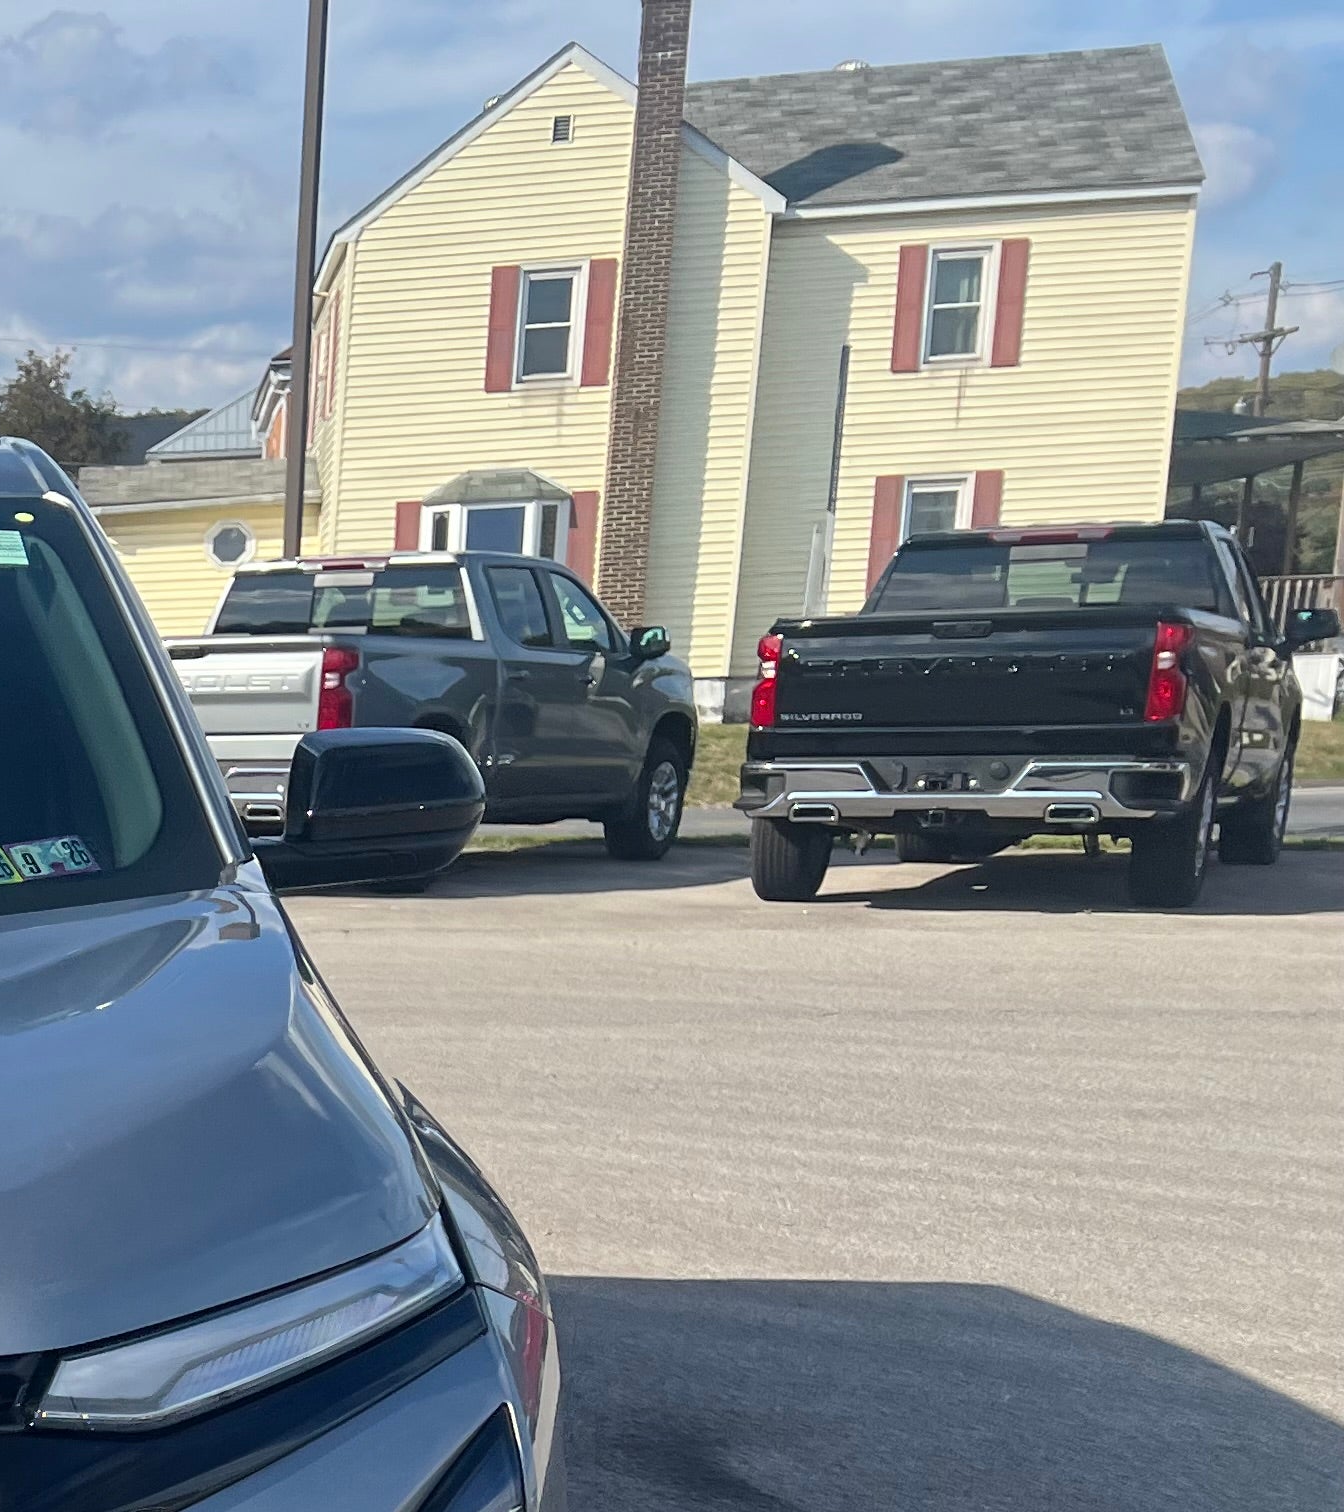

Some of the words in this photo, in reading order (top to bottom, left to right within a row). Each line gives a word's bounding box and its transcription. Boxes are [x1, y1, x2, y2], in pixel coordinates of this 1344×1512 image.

[779, 712, 863, 721] SILVERADO
[22, 852, 42, 874] 9
[61, 840, 90, 866] 26
